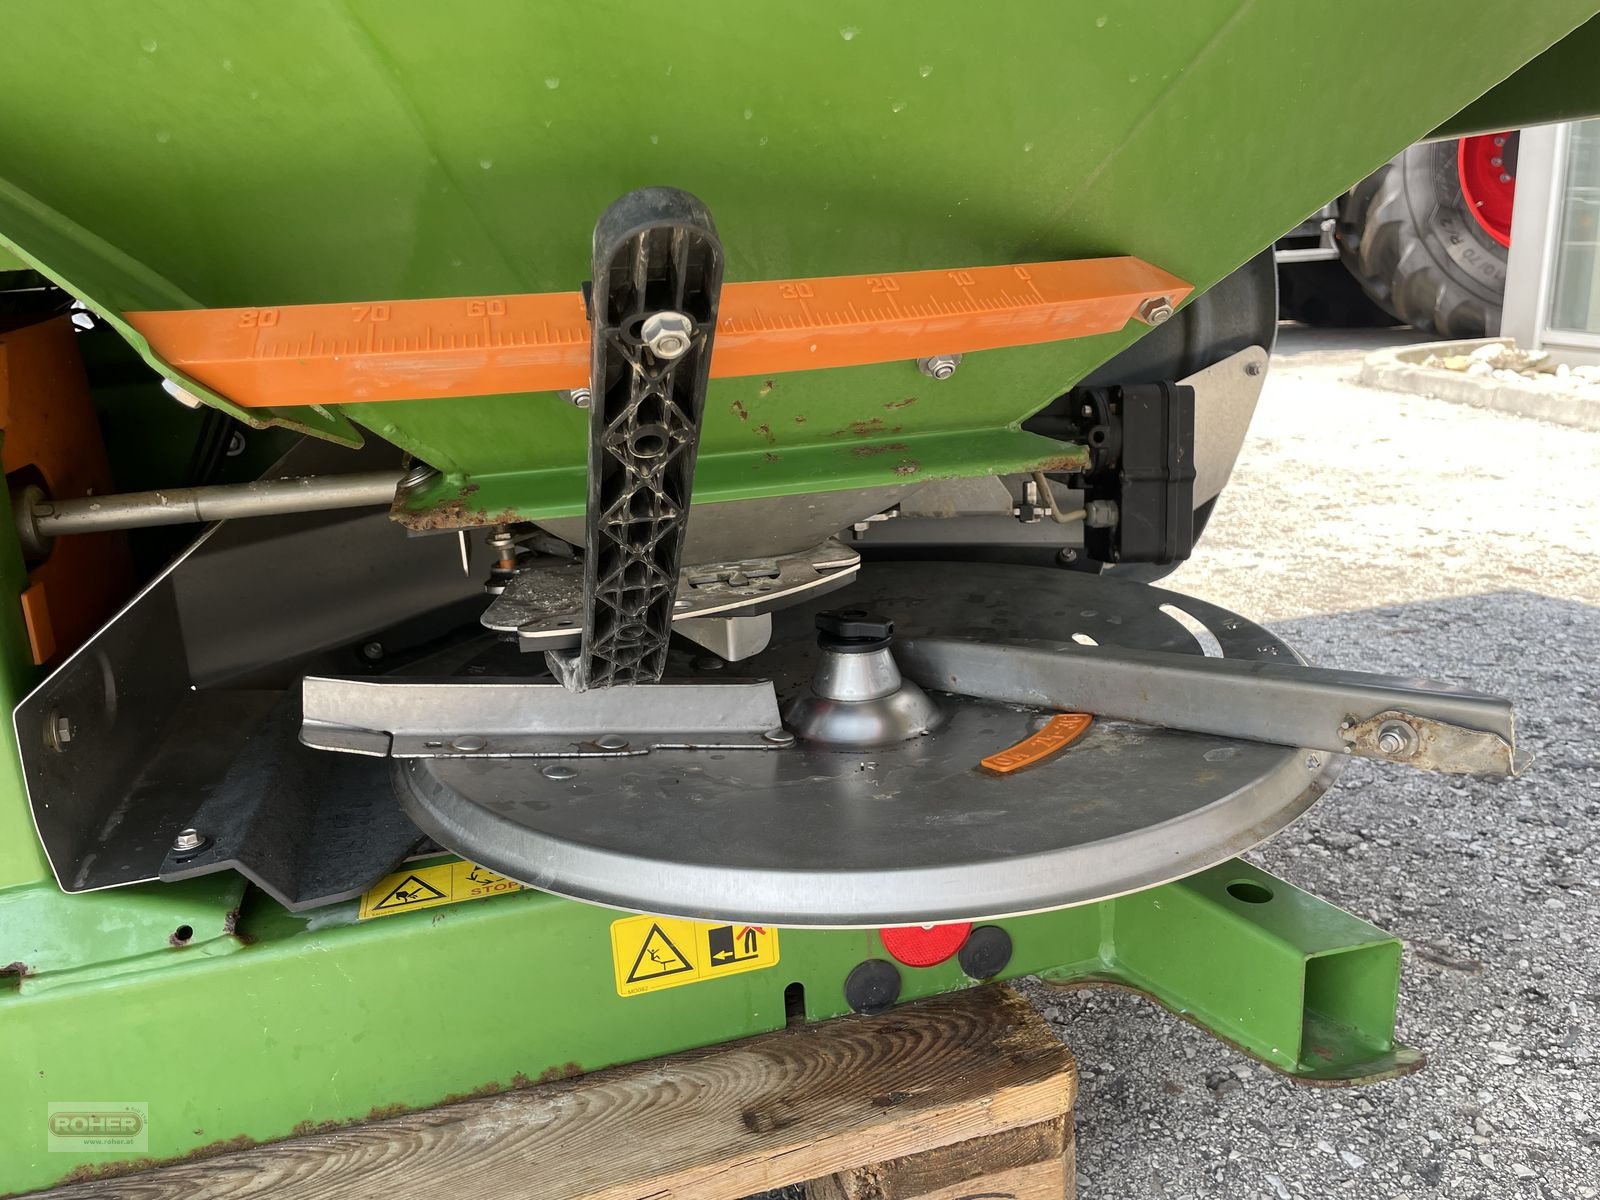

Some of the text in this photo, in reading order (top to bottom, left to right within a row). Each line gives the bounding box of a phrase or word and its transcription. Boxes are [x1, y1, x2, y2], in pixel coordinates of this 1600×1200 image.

[237, 308, 280, 328] 80
[351, 304, 391, 323] 70
[466, 299, 507, 318] 60
[779, 282, 814, 300] 30
[866, 276, 900, 294] 20
[948, 270, 977, 288] 10
